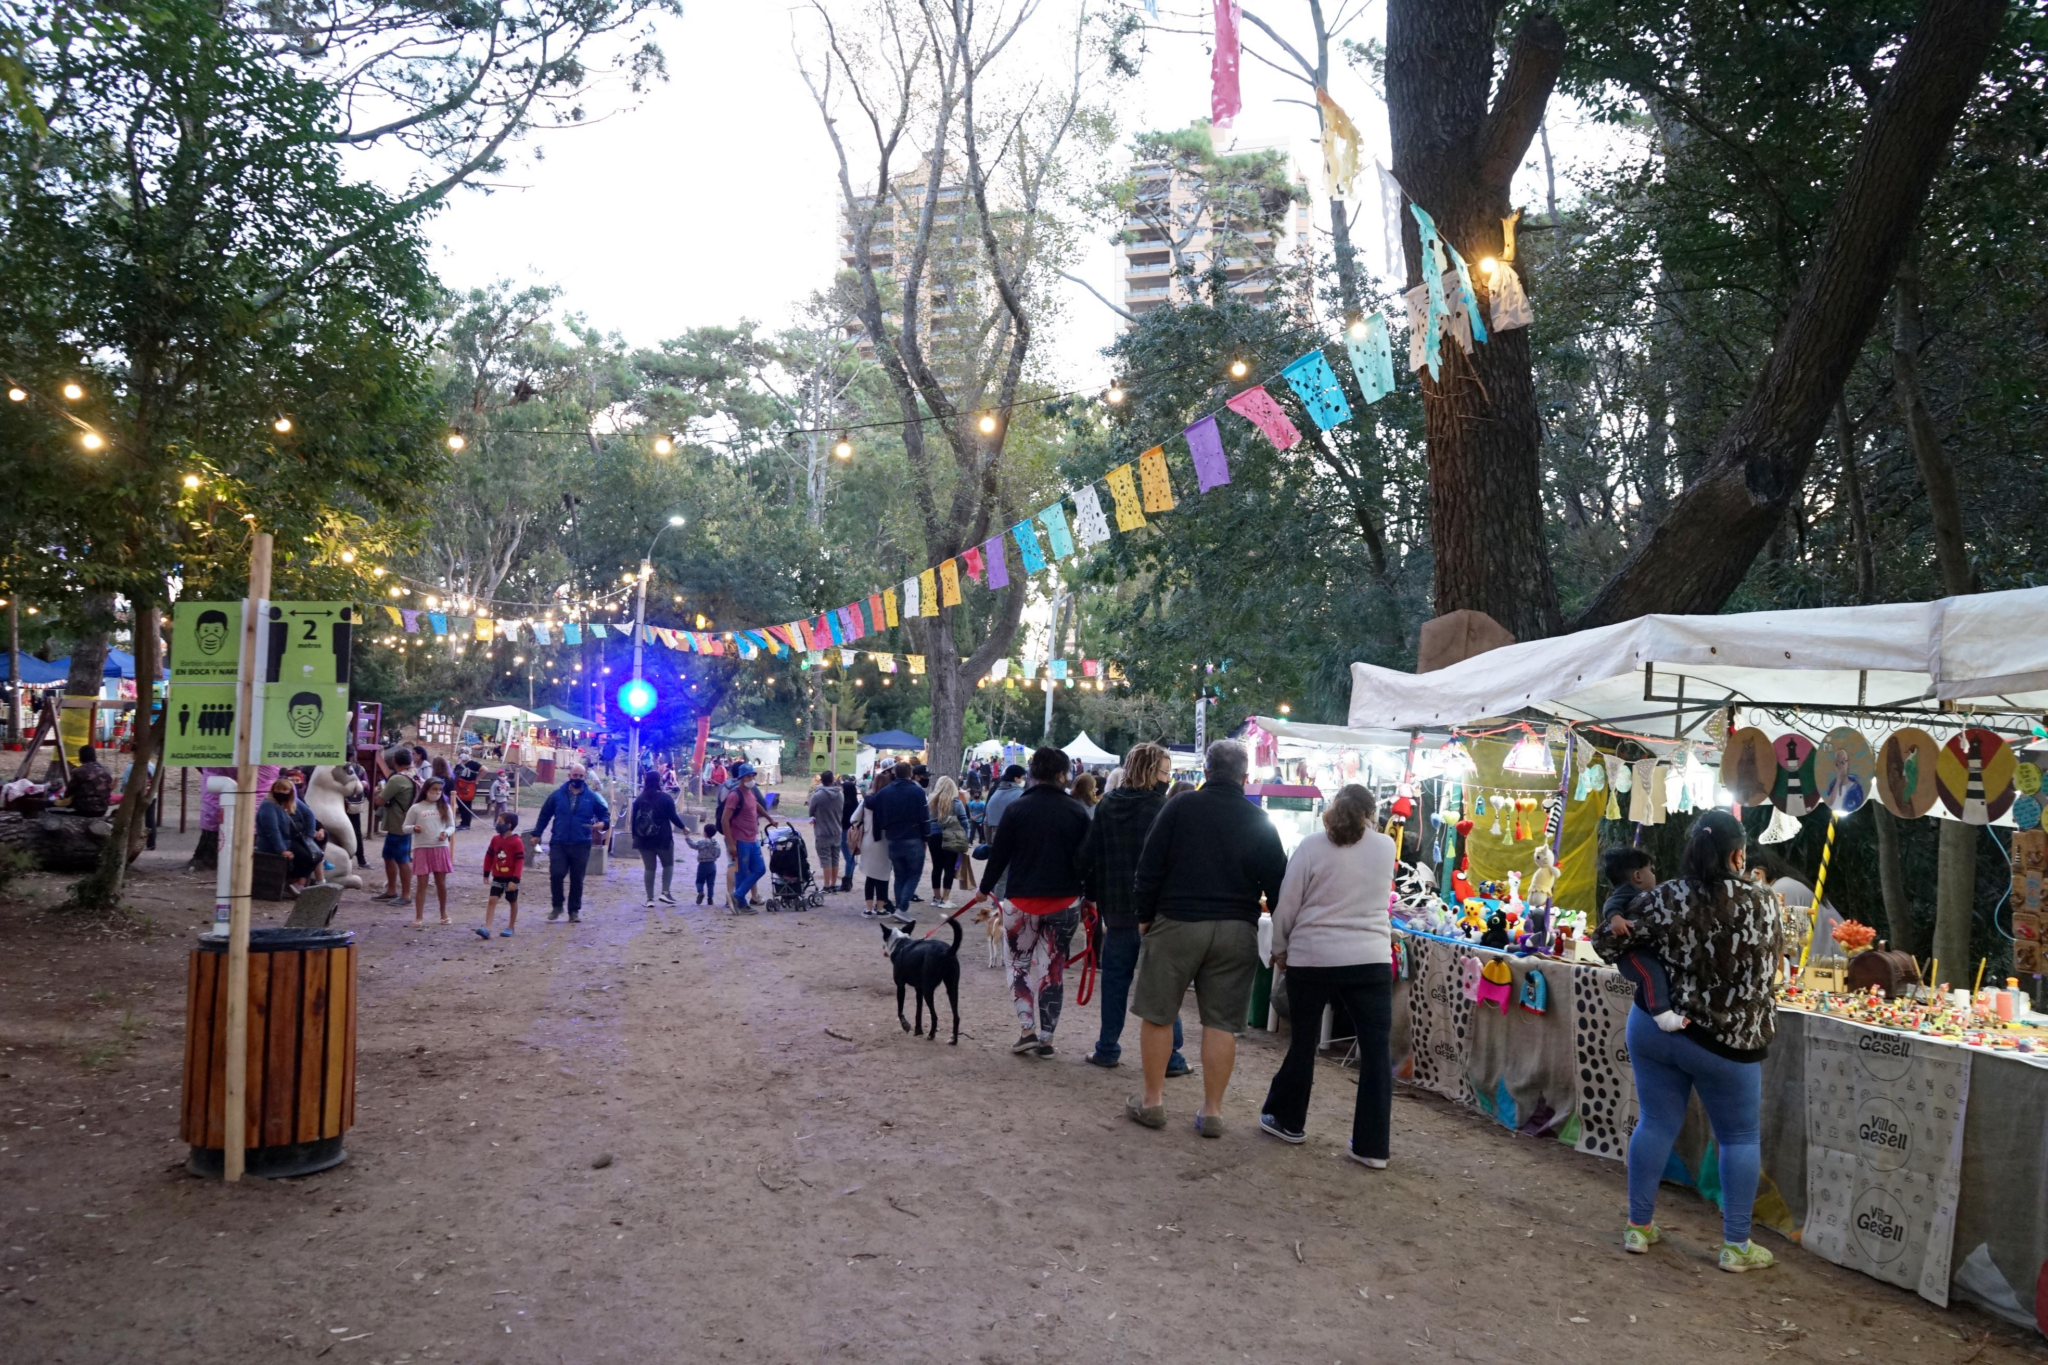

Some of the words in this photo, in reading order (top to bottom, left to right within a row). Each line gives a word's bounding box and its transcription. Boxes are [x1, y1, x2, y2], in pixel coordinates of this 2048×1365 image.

[303, 620, 317, 640] 2
[273, 742, 297, 750] Barbijo
[298, 742, 334, 751] obligatorio
[1859, 1034, 1910, 1058] Gesell
[1871, 1115, 1898, 1134] Villa
[1859, 1123, 1907, 1150] Gesell
[1857, 1213, 1903, 1242] Gesell
